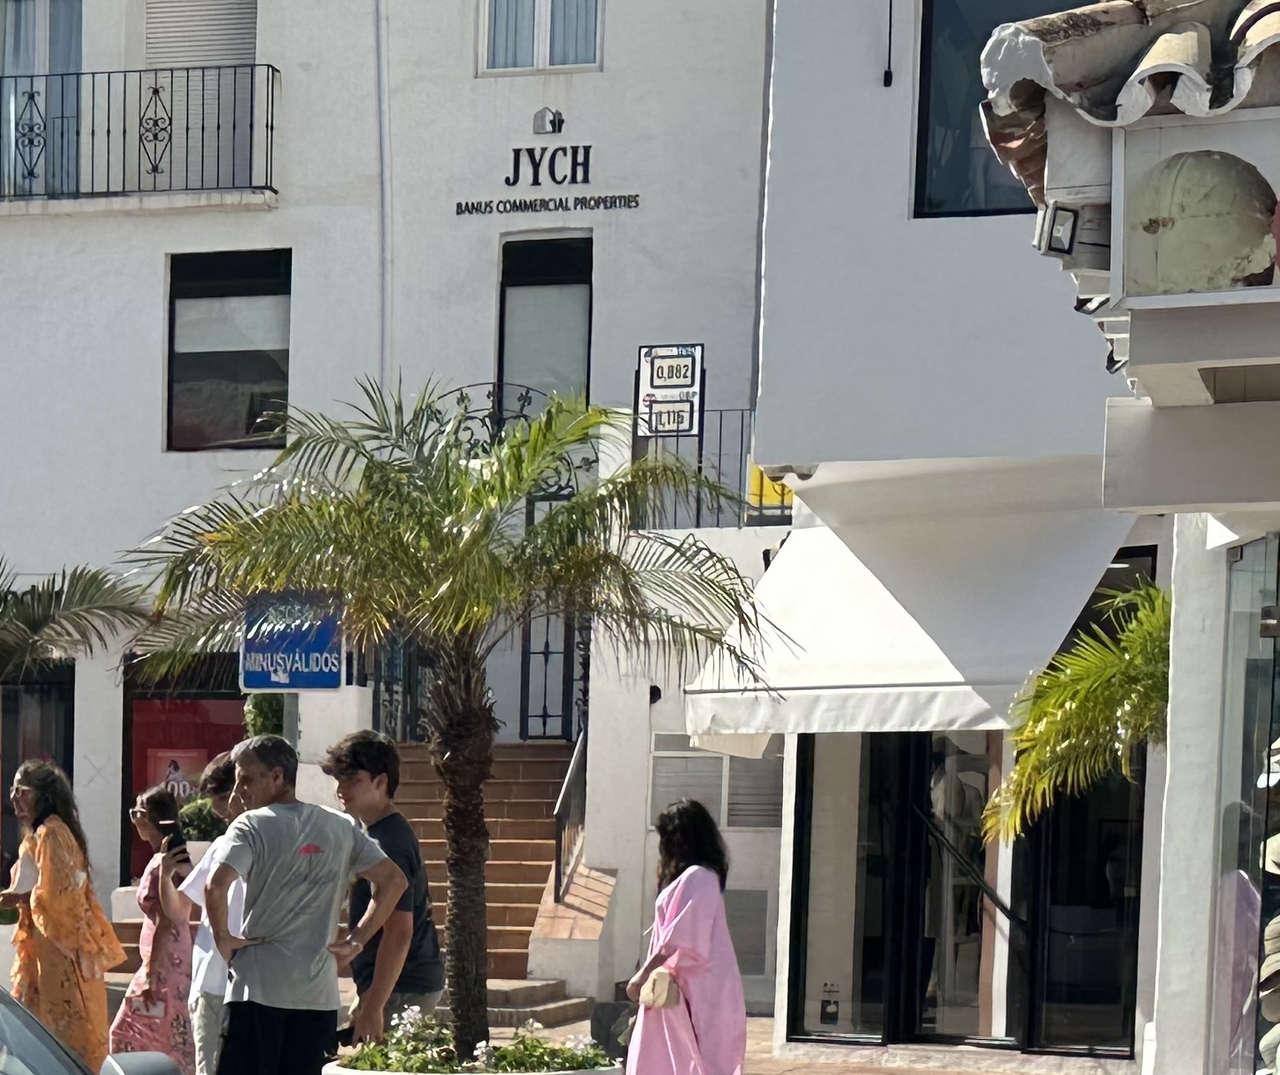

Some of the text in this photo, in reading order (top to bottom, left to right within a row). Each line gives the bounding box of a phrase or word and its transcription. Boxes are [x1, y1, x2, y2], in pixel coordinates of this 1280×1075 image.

[504, 145, 593, 186] JYCH
[455, 194, 640, 216] BANUS COMMERCIAL PROPERTIES
